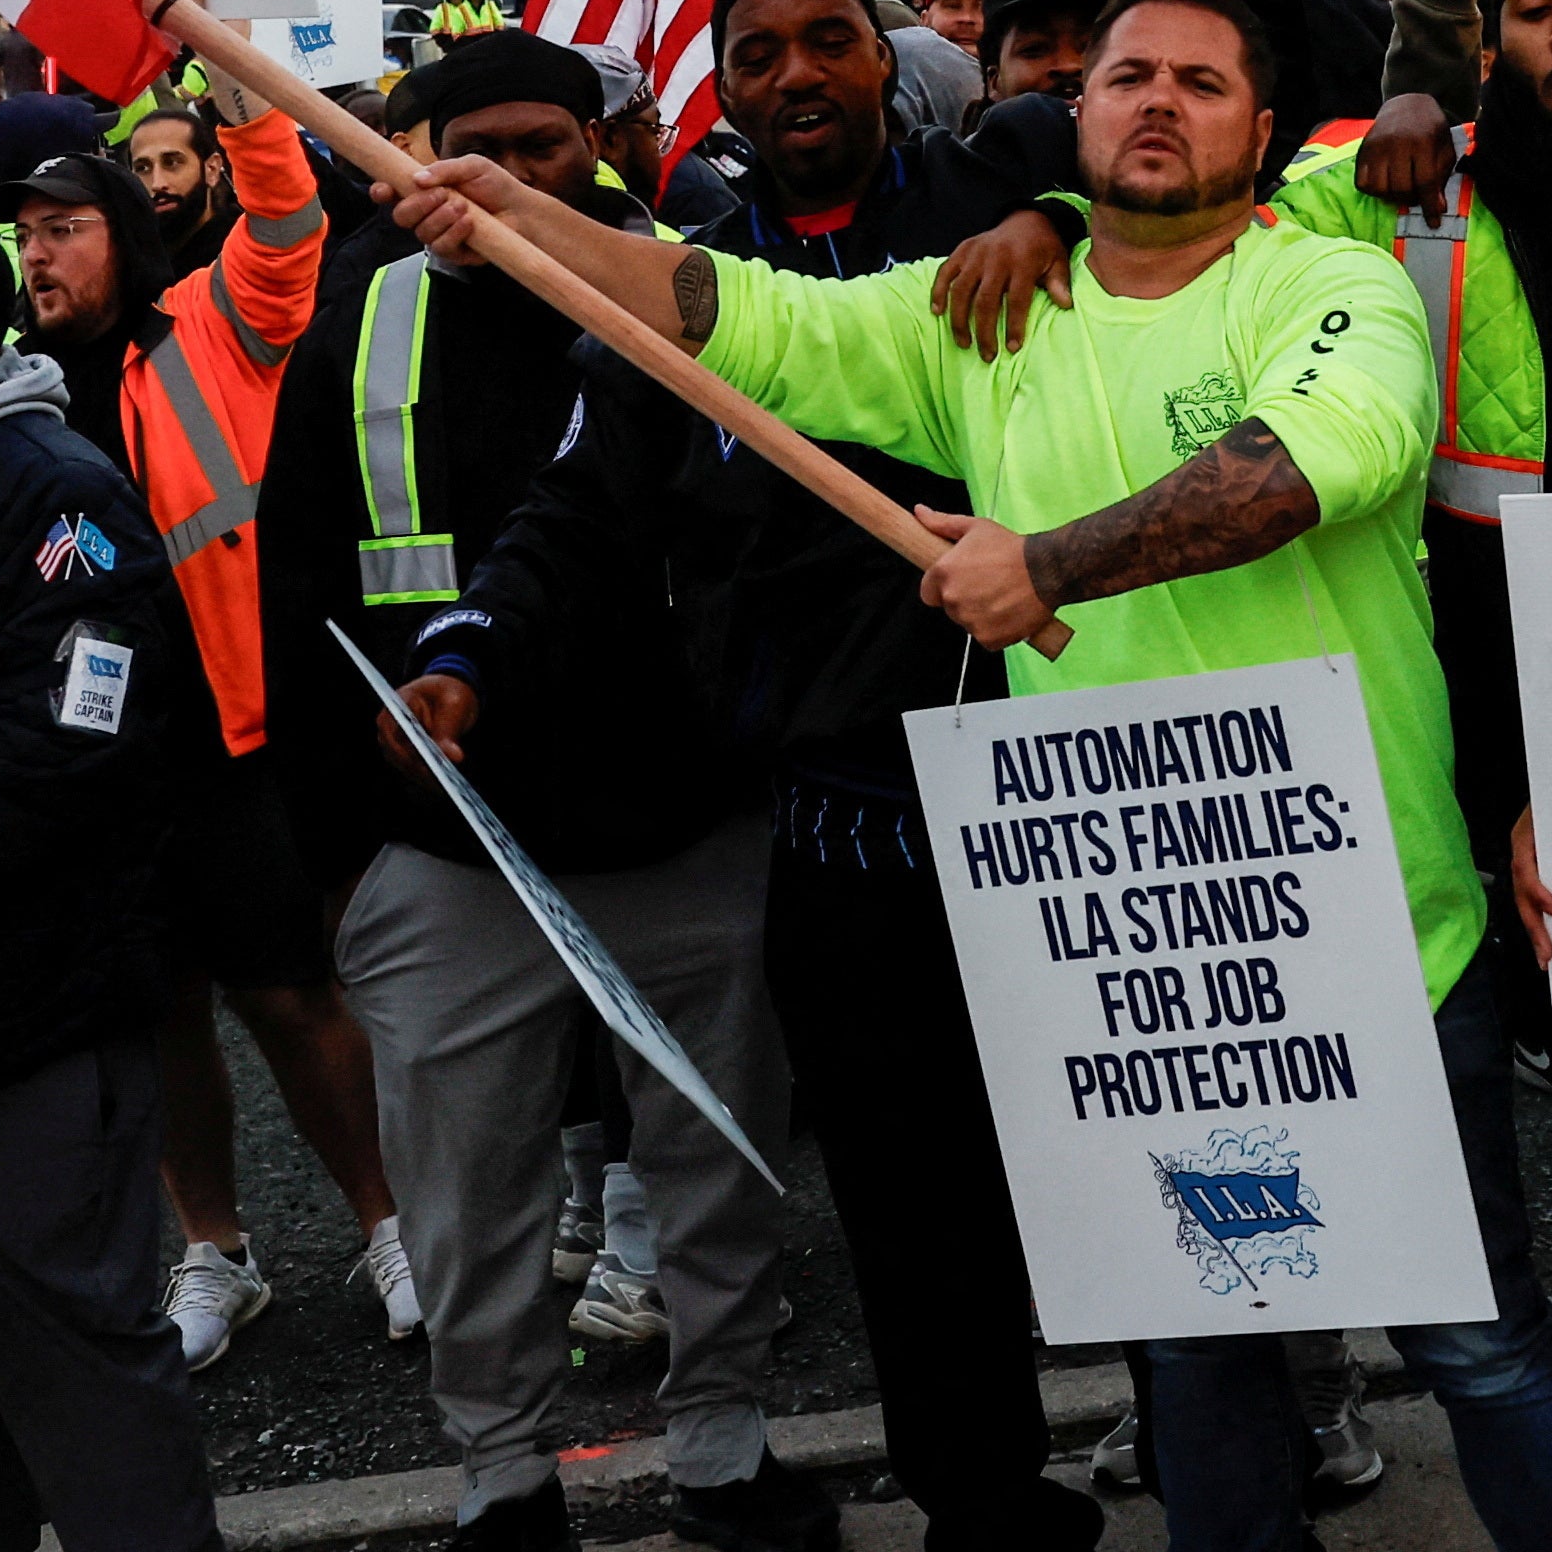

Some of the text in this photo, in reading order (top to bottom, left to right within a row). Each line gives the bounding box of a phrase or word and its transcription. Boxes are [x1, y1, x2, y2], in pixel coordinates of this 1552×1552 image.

[74, 703, 115, 724] CAPTAIN
[79, 689, 114, 710] STRIKE
[992, 705, 1293, 806] AUTOMATION
[960, 784, 1357, 889] HURTS FAMILIES:
[1039, 871, 1309, 961] ILA STANDS
[1096, 958, 1286, 1037] FOR JOB
[1064, 1033, 1357, 1120] PROTECTION
